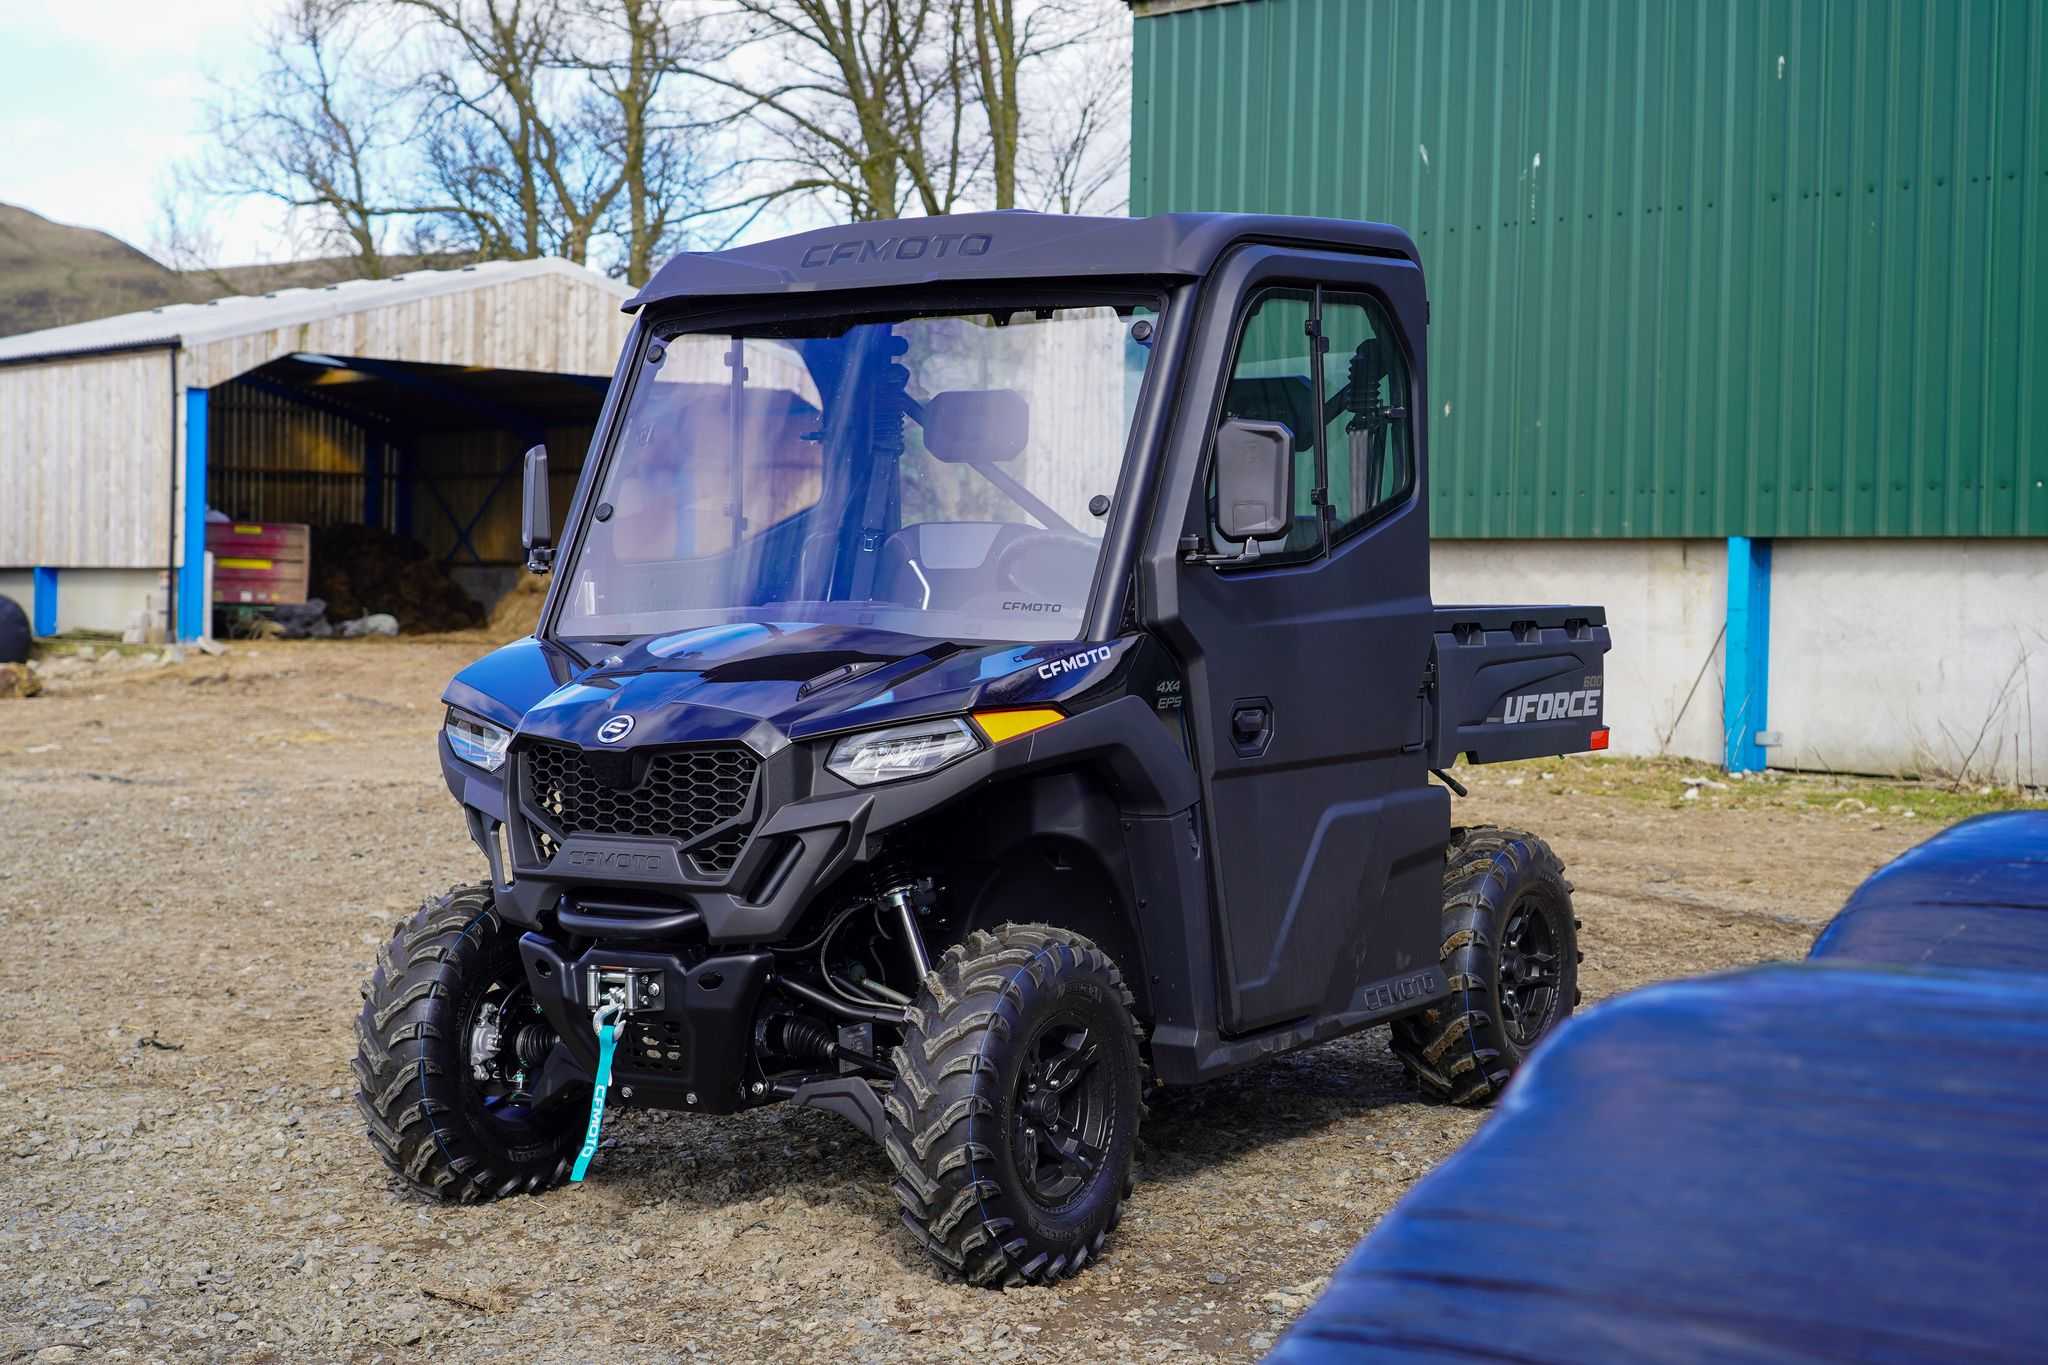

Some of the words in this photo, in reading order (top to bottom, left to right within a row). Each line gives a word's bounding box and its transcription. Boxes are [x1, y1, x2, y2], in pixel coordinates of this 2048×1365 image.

[800, 232, 994, 268] CFMOTO
[1002, 601, 1062, 613] CFMOTO
[1038, 645, 1111, 680] CFMOTO
[1158, 696, 1182, 709] EPS
[1503, 689, 1601, 725] UFORCE
[568, 850, 664, 871] CFMOTO
[1363, 972, 1435, 1011] CFMOTO
[581, 1084, 608, 1158] CFMOTO
